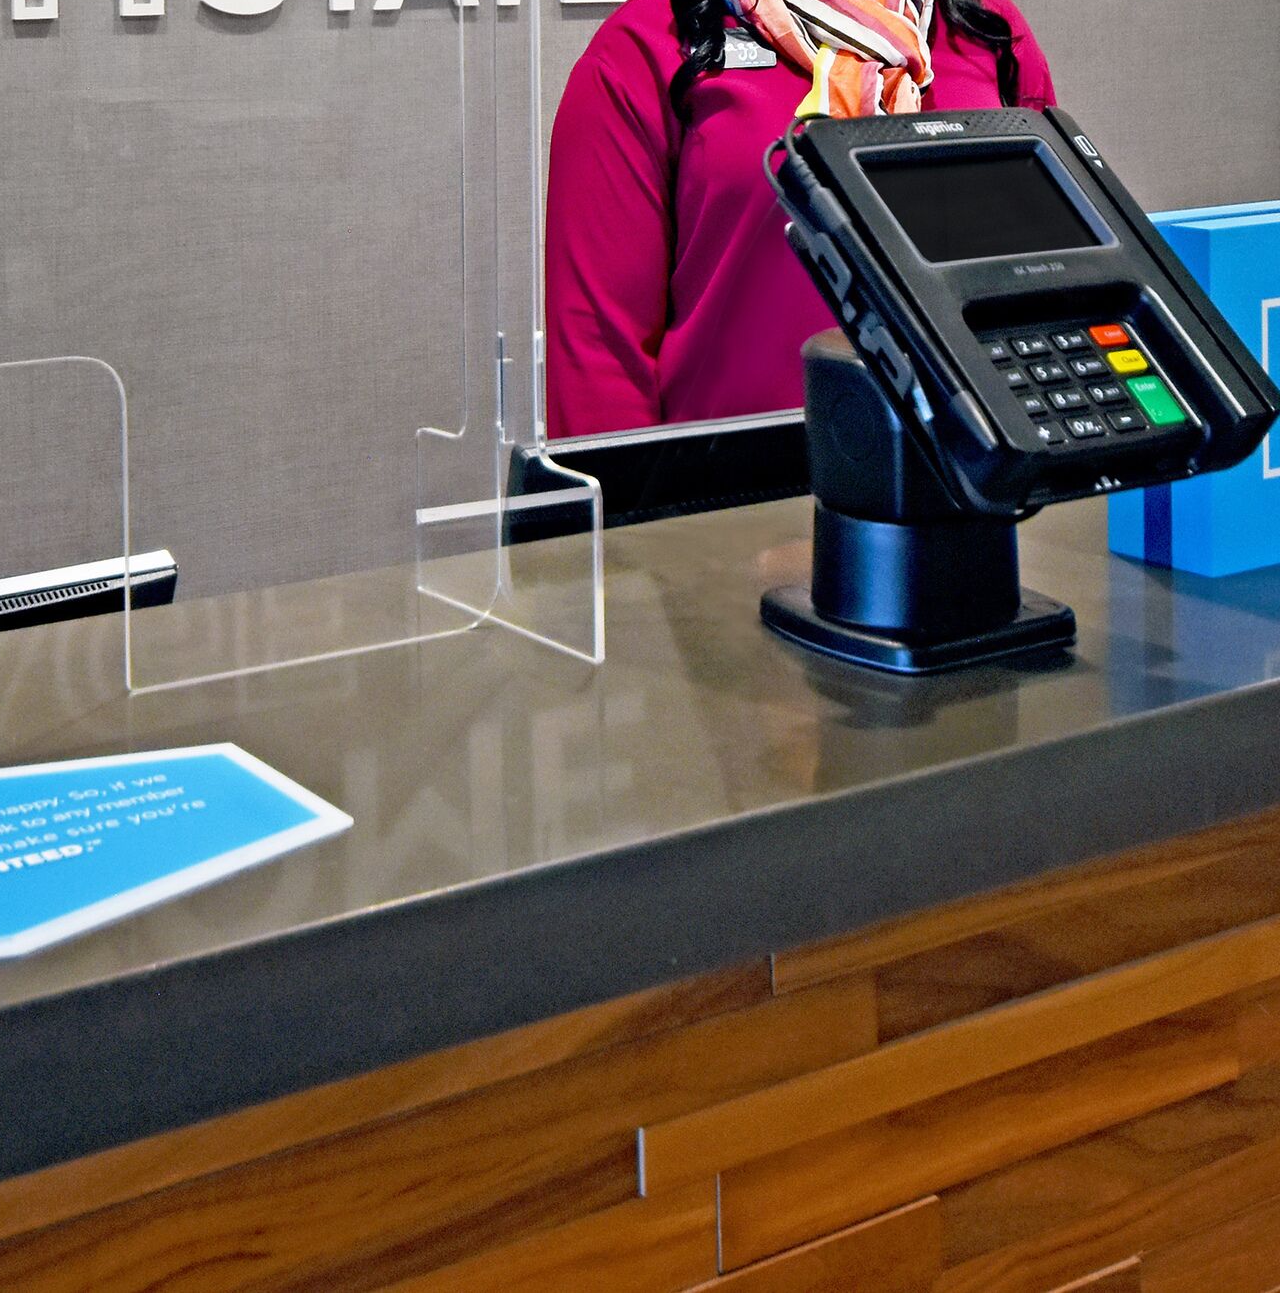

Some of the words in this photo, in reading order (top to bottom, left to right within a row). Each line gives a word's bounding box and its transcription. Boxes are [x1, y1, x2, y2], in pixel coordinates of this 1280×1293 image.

[912, 120, 965, 136] ingenico
[1019, 341, 1029, 352] 2
[1058, 336, 1068, 346] 3
[1076, 361, 1086, 372] 6
[1036, 367, 1047, 378] 5
[1135, 382, 1157, 391] Enter
[1093, 388, 1104, 399] 9
[1055, 394, 1066, 405] 8
[68, 787, 108, 800] So,
[109, 780, 127, 792] if
[131, 773, 168, 787] we
[21, 815, 48, 828] to
[53, 806, 91, 823] any
[96, 785, 185, 812] member
[66, 818, 120, 838] sure
[127, 797, 206, 826] you're
